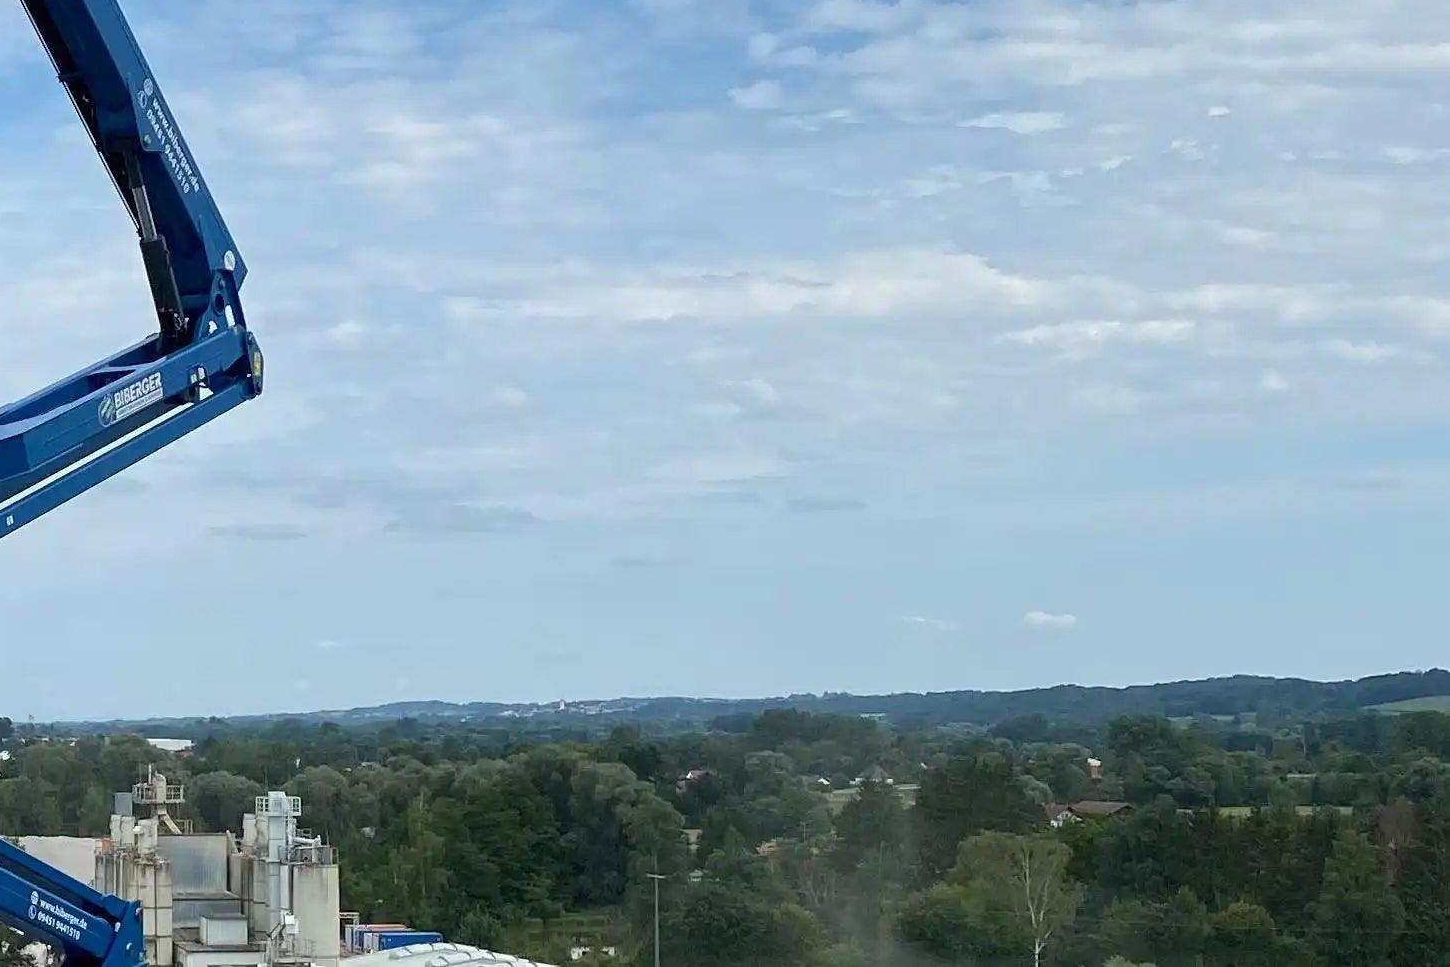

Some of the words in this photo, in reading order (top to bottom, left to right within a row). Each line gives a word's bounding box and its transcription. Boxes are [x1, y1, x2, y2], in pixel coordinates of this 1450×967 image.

[153, 98, 199, 192] www.biberger.de
[114, 372, 161, 408] BIBERGER
[38, 911, 55, 927] 09451
[56, 921, 80, 940] 9441510
[40, 900, 87, 929] www.biberger.de
